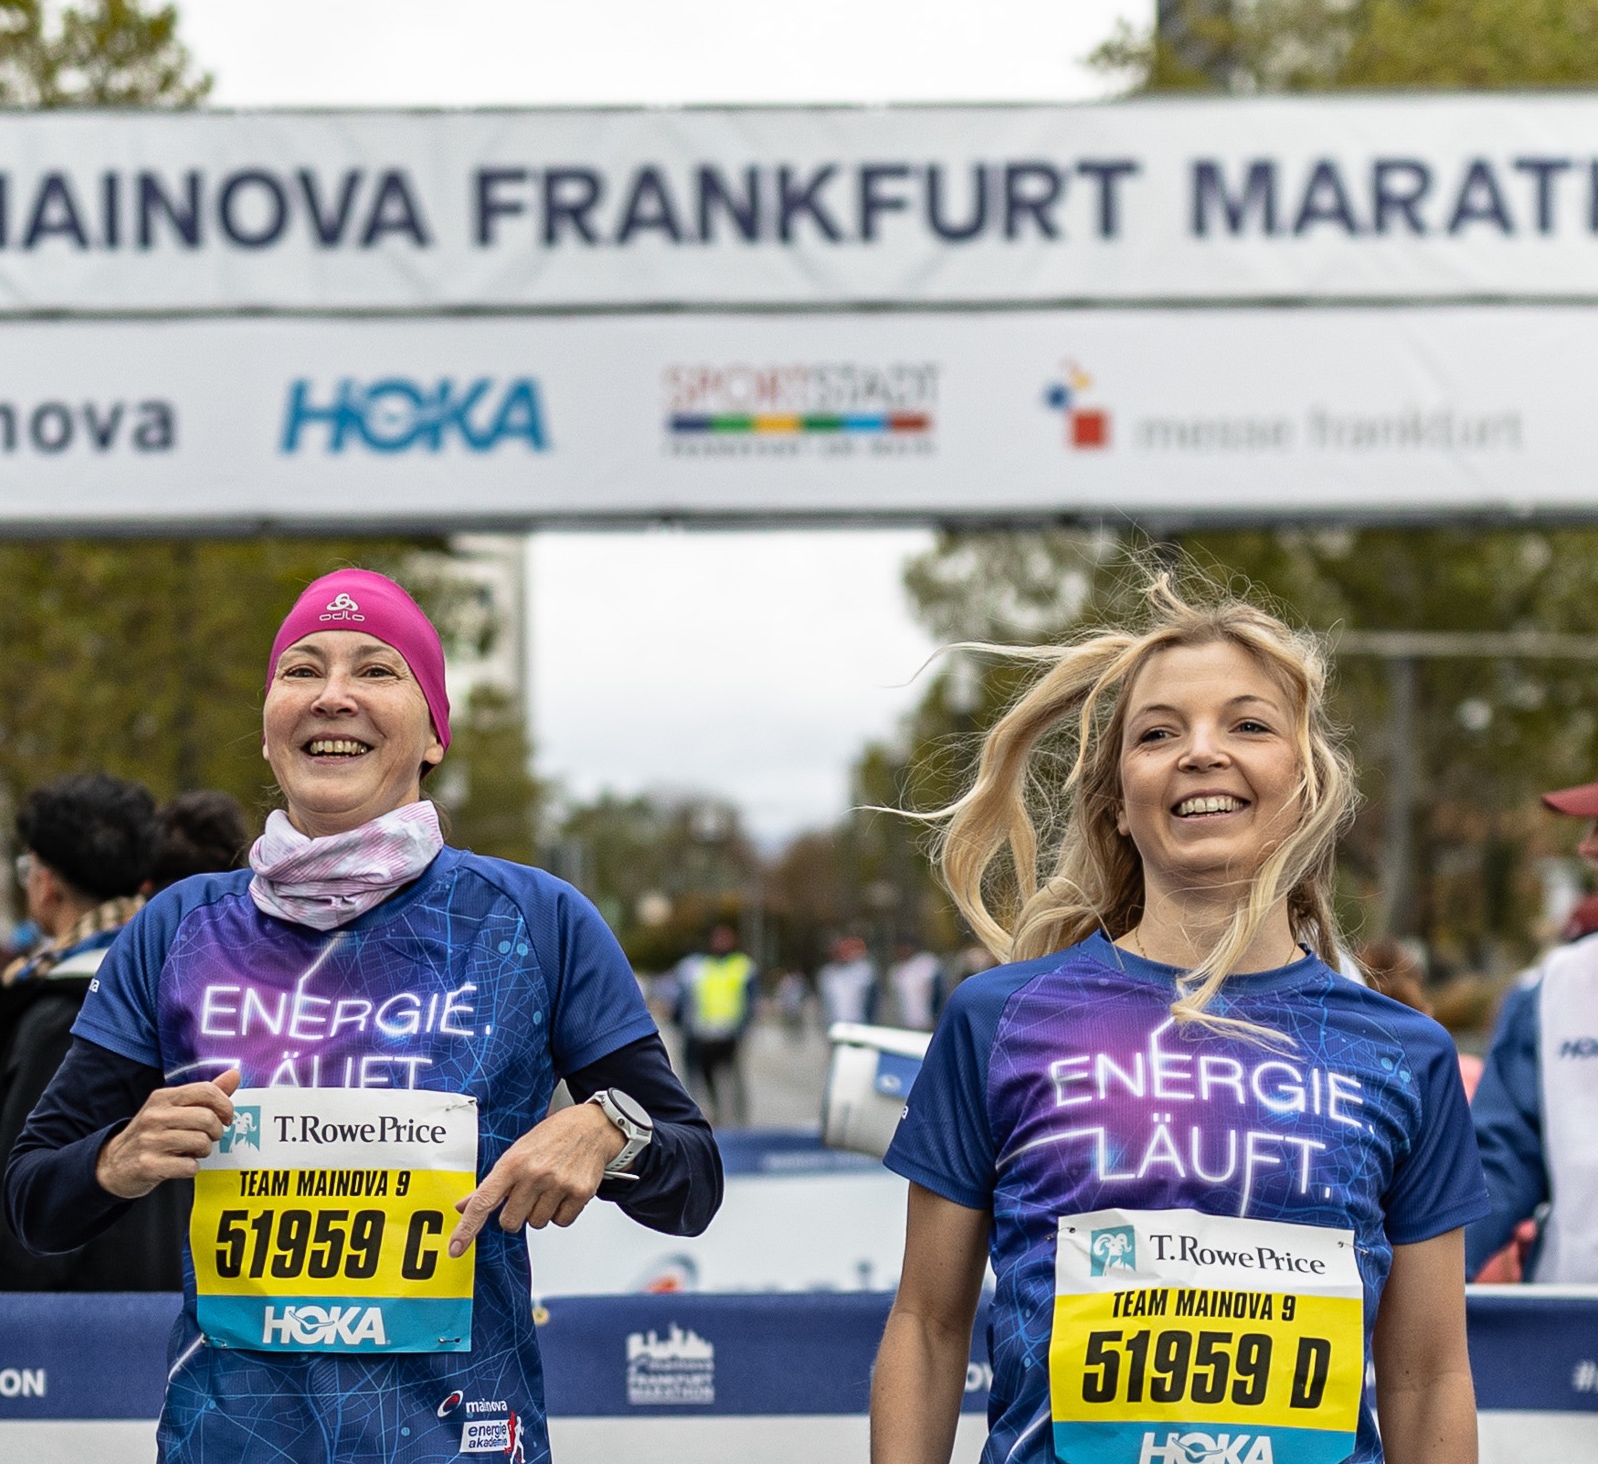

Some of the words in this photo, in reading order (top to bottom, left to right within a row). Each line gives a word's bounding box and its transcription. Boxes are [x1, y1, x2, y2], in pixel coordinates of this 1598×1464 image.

[473, 160, 1141, 248] FRANKFURT
[279, 377, 551, 455] HOKA
[319, 610, 365, 621] odlo
[234, 1050, 433, 1089] ÄUFT
[239, 1170, 290, 1198] TEAM
[295, 1170, 389, 1198] MAINOVA
[395, 1170, 409, 1198] 9
[215, 1209, 384, 1280] 51959
[402, 1212, 443, 1282] C
[263, 1305, 386, 1346] HOKA
[1112, 1289, 1168, 1320] TEAM
[1174, 1290, 1274, 1322] MAINOVA
[1280, 1296, 1296, 1322] 9
[1082, 1330, 1274, 1406] 51959
[1290, 1337, 1332, 1410] D
